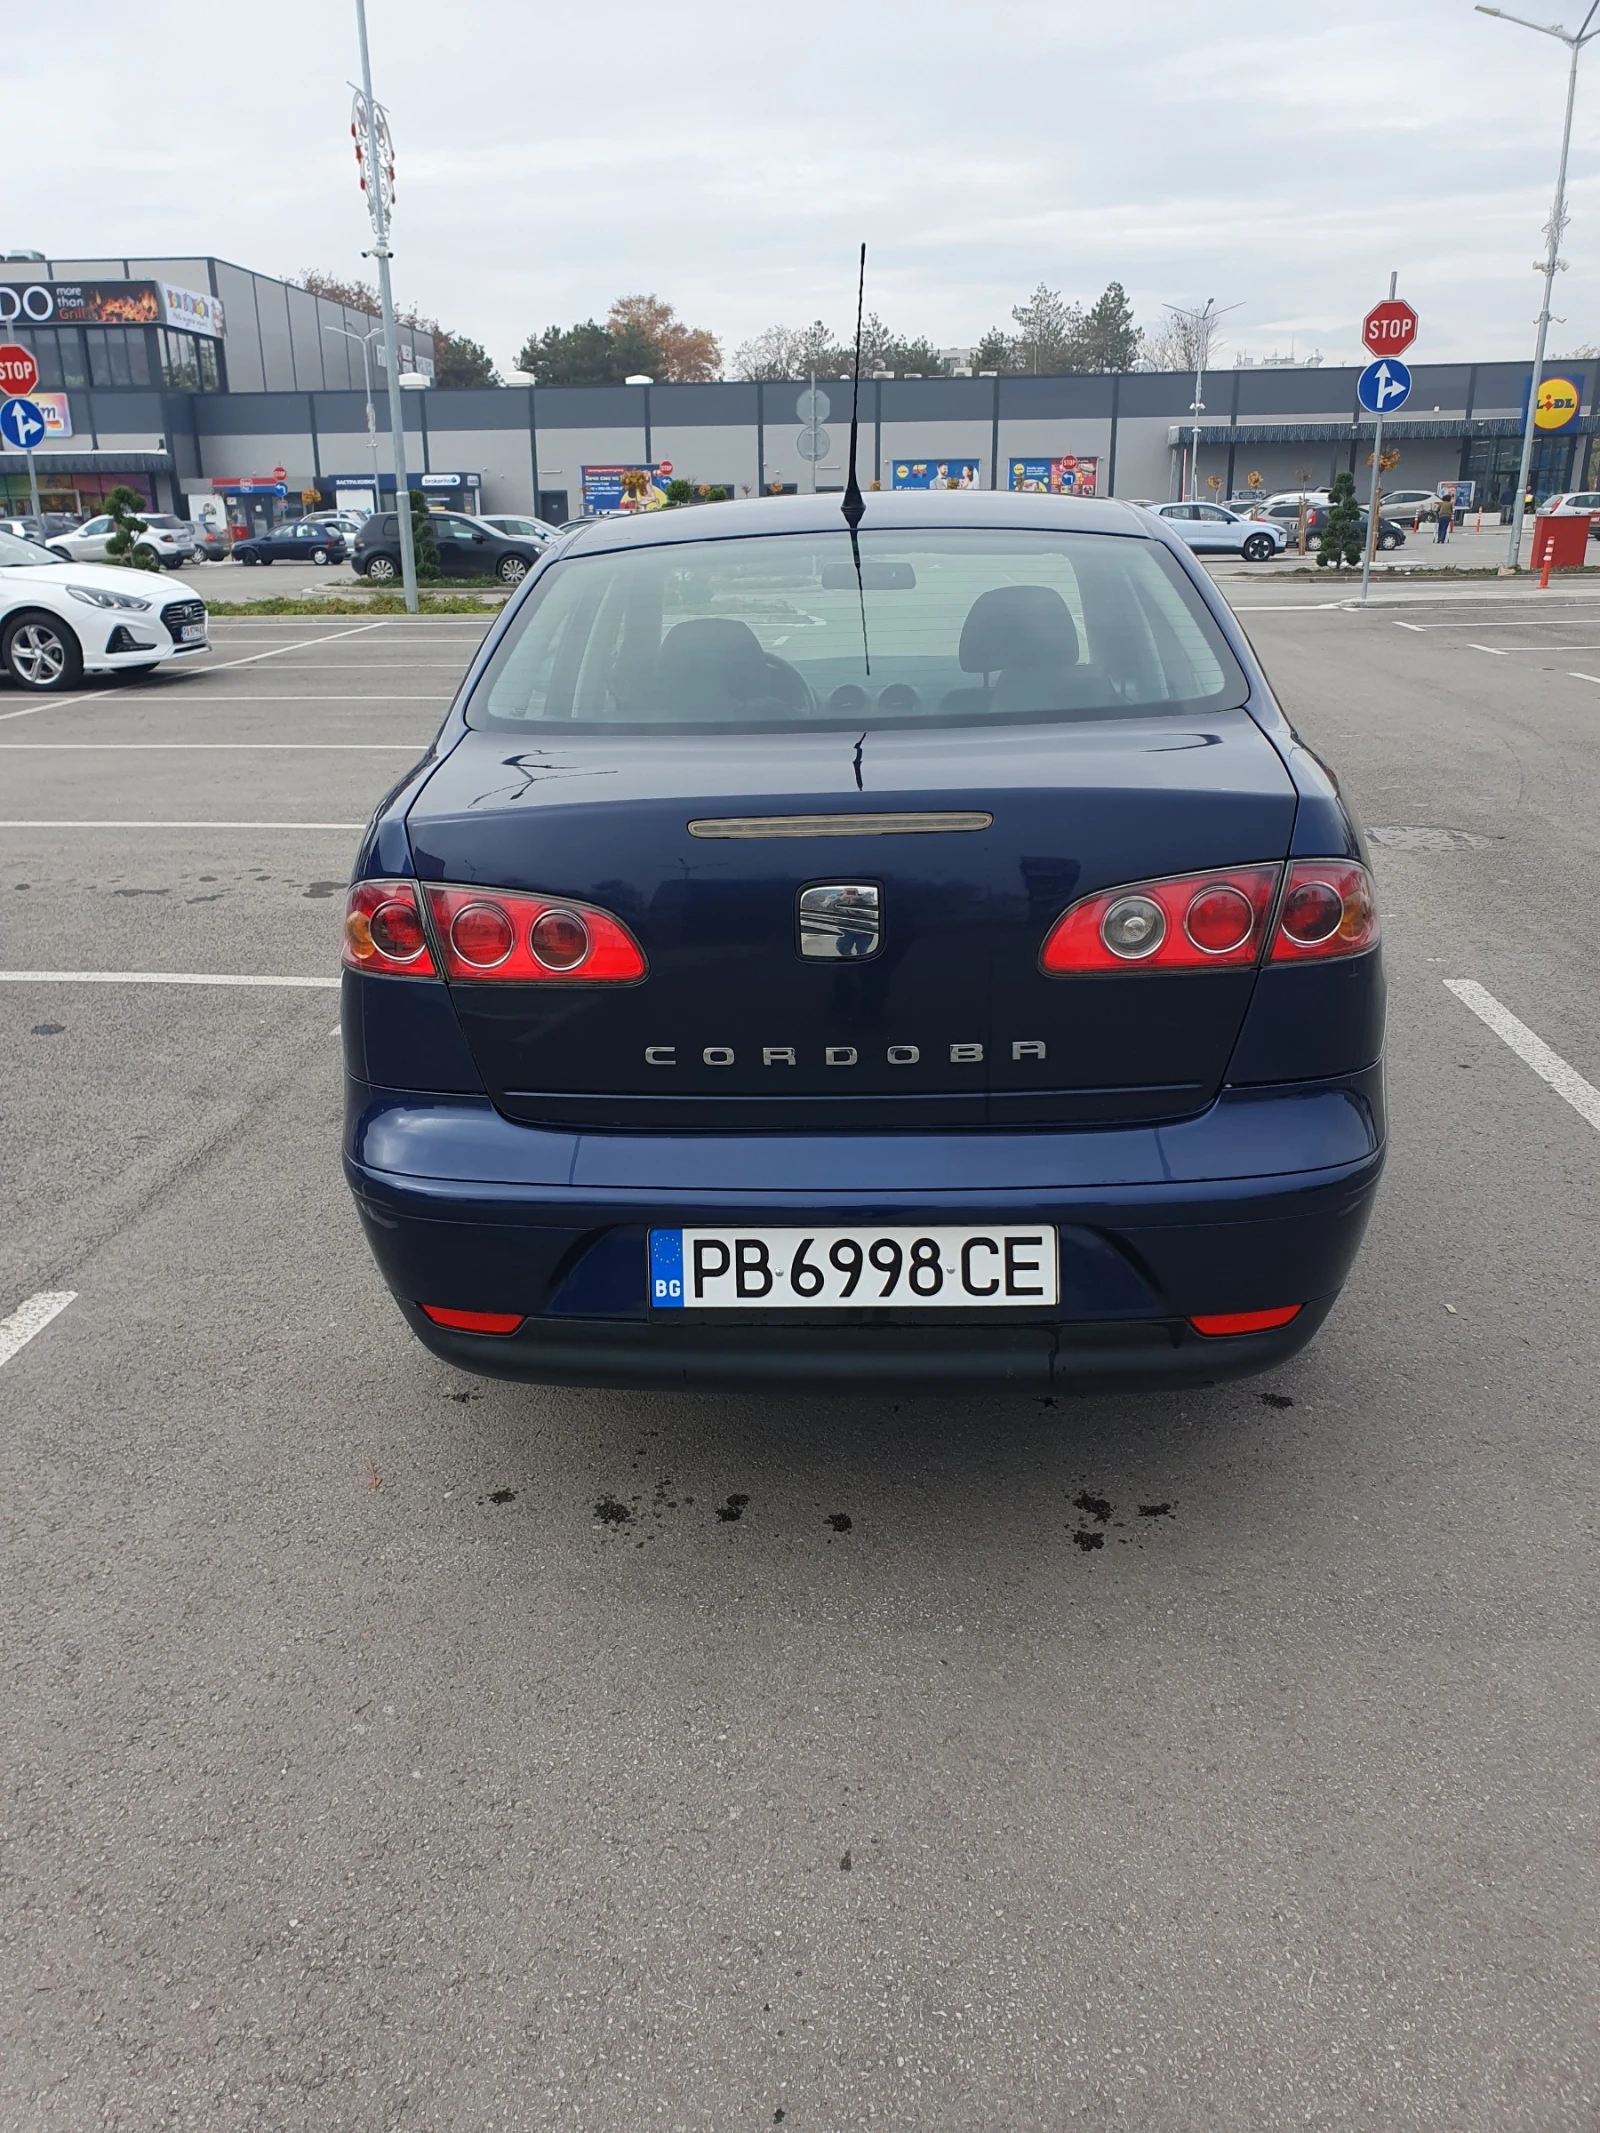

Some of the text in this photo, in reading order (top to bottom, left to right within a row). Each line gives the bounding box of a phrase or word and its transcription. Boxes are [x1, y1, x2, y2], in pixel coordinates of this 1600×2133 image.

[56, 287, 82, 296] more
[57, 296, 84, 308] than
[59, 307, 85, 320] Grill
[1368, 318, 1412, 339] STOP
[0, 361, 33, 380] STOP
[645, 1040, 1046, 1066] CORDOBA
[693, 1236, 1044, 1299] PB 6998 CE
[656, 1279, 681, 1297] BG
